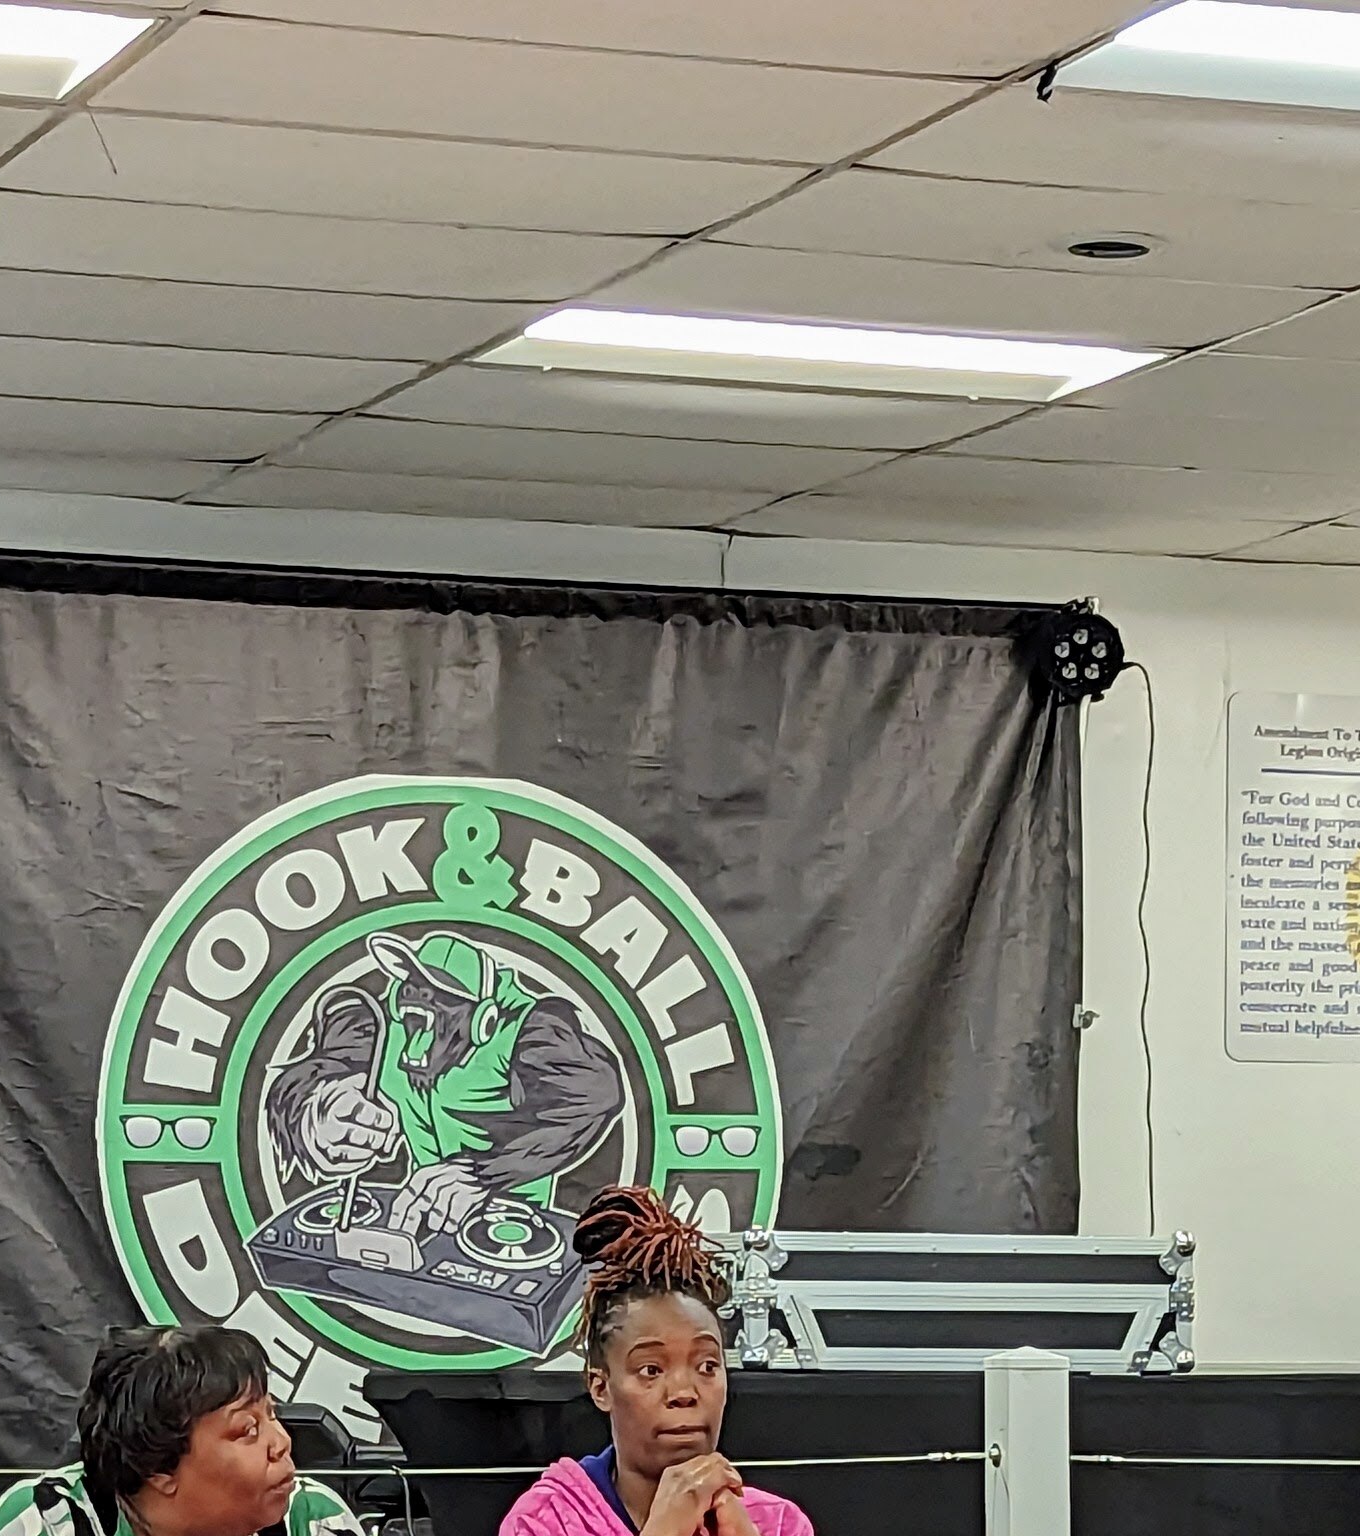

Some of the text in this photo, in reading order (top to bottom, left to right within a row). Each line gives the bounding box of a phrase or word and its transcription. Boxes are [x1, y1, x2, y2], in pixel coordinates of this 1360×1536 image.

[1333, 728, 1351, 741] To
[1279, 792, 1310, 807] God
[1242, 812, 1310, 831] following
[1242, 833, 1265, 847] the
[1272, 834, 1321, 848] United
[1241, 854, 1284, 867] foster
[1289, 855, 1314, 868] and
[1241, 874, 1264, 888] the
[1240, 918, 1276, 930] state
[1281, 917, 1306, 930] and
[1240, 937, 1266, 950] and
[1271, 937, 1293, 951] the
[142, 818, 428, 1094] HOOK
[518, 838, 736, 1105] BALL
[1240, 960, 1280, 975] peace
[1289, 959, 1314, 973] and
[1322, 960, 1357, 976] good
[1311, 980, 1333, 993] the
[1323, 1001, 1349, 1014] and
